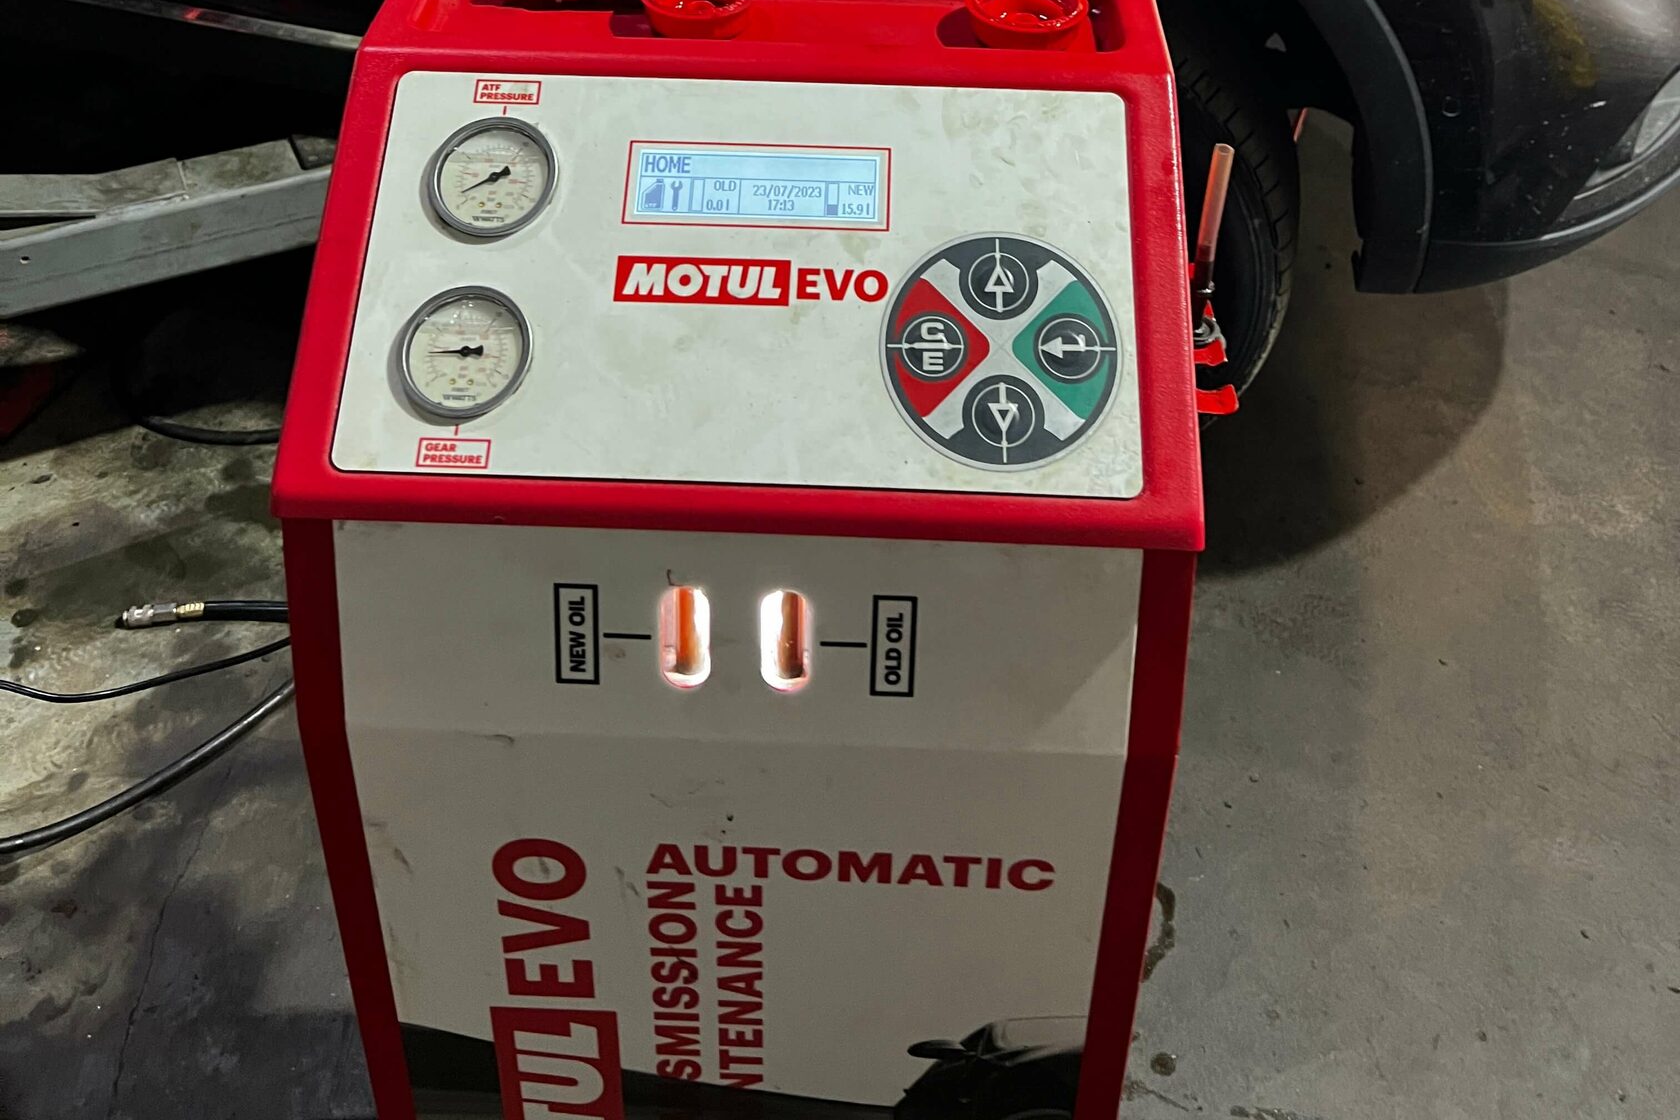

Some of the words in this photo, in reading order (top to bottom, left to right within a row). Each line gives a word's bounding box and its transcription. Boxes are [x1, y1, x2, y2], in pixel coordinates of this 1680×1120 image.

[480, 92, 534, 101] PRESSURE
[481, 83, 501, 91] ATF
[644, 155, 692, 174] HOME
[713, 180, 737, 192] OLD
[752, 185, 822, 199] 23/07/2023
[848, 184, 874, 196] NEW
[767, 199, 795, 212] 17:13
[622, 263, 782, 300] MOTUL
[796, 267, 888, 303] EVO
[425, 443, 457, 453] GEAR
[423, 454, 483, 464] PRESSURE
[568, 596, 585, 626] OIL
[886, 612, 903, 643] OIL
[569, 631, 586, 672] NEW
[884, 648, 902, 685] OLD
[646, 843, 1056, 891] AUTOMATIC
[491, 838, 596, 999] EVO
[646, 880, 702, 1082] SMISSION
